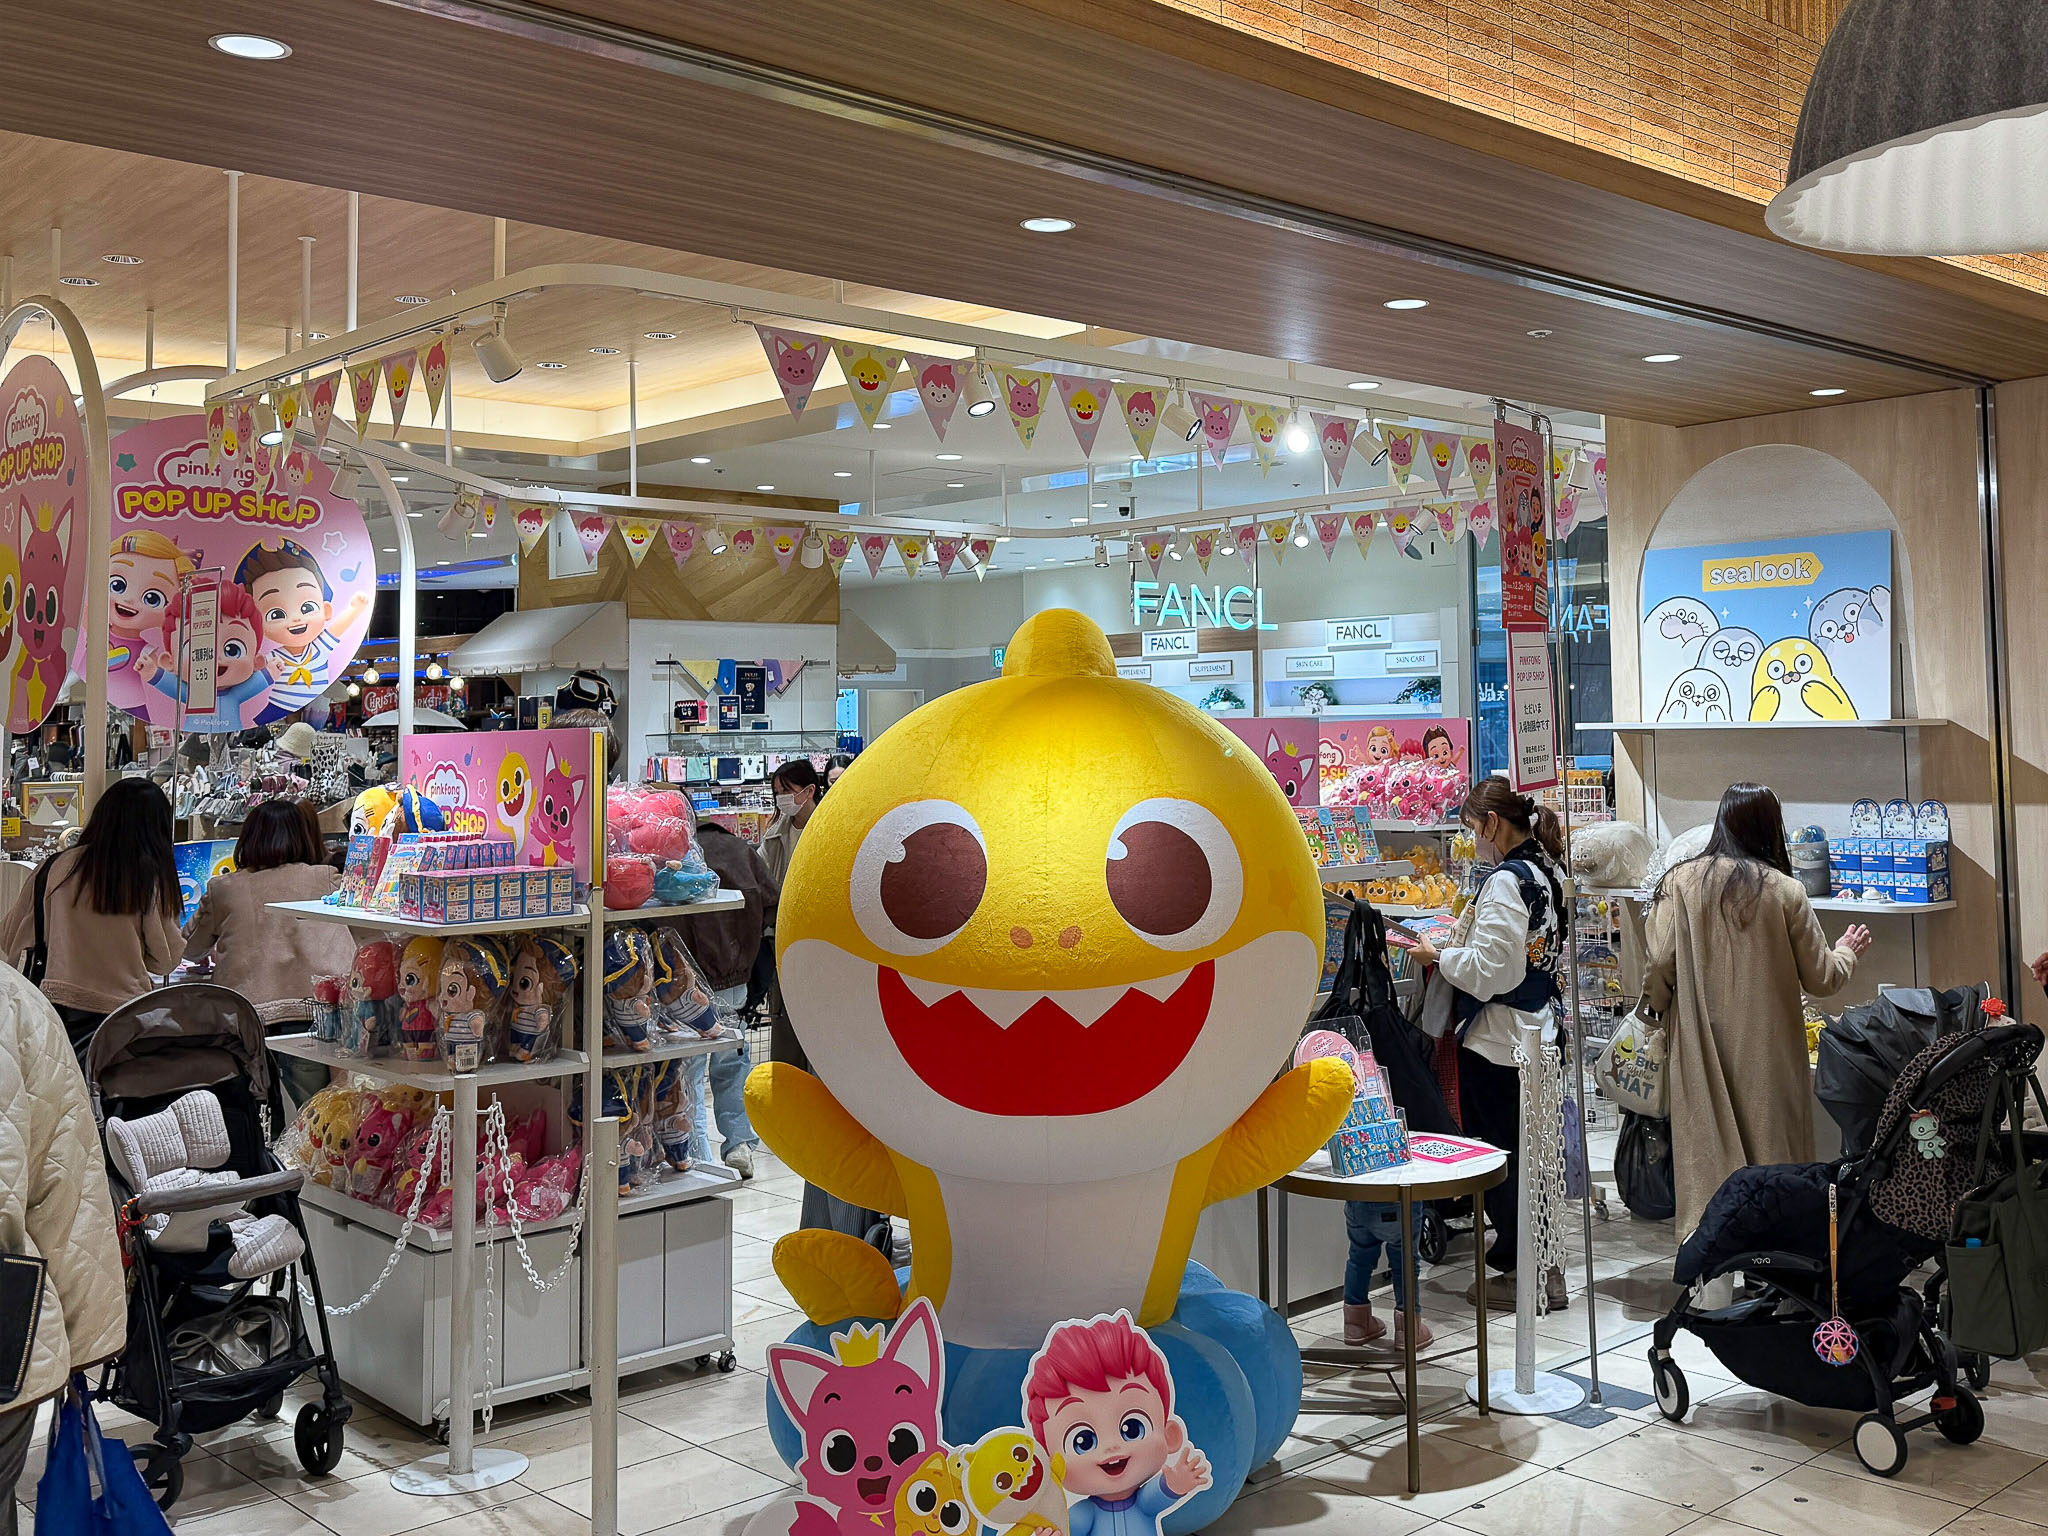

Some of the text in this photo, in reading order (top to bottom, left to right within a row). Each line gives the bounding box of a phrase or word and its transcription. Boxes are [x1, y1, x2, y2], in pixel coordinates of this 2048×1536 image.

[11, 412, 41, 438] pinkfong
[0, 442, 63, 483] OP UP SHOP
[177, 460, 256, 488] pinkfng
[123, 490, 316, 524] POP UP SHOP
[1709, 557, 1813, 586] sealook
[1133, 580, 1279, 632] FANCL
[1335, 623, 1382, 641] FANCL
[1150, 636, 1190, 651] FANCL
[1194, 664, 1226, 674] SUPPLEMENT
[1295, 660, 1323, 668] SKIN CARE
[1395, 655, 1425, 664] SKIN CARE
[1519, 655, 1542, 666] PINKFONG
[1523, 703, 1543, 716] ただいま
[1518, 719, 1551, 735] 入場制限中です
[430, 782, 461, 805] pinkfong
[453, 810, 486, 833] SHOP
[1635, 1055, 1661, 1073] BIG
[1617, 1069, 1656, 1100] HAT
